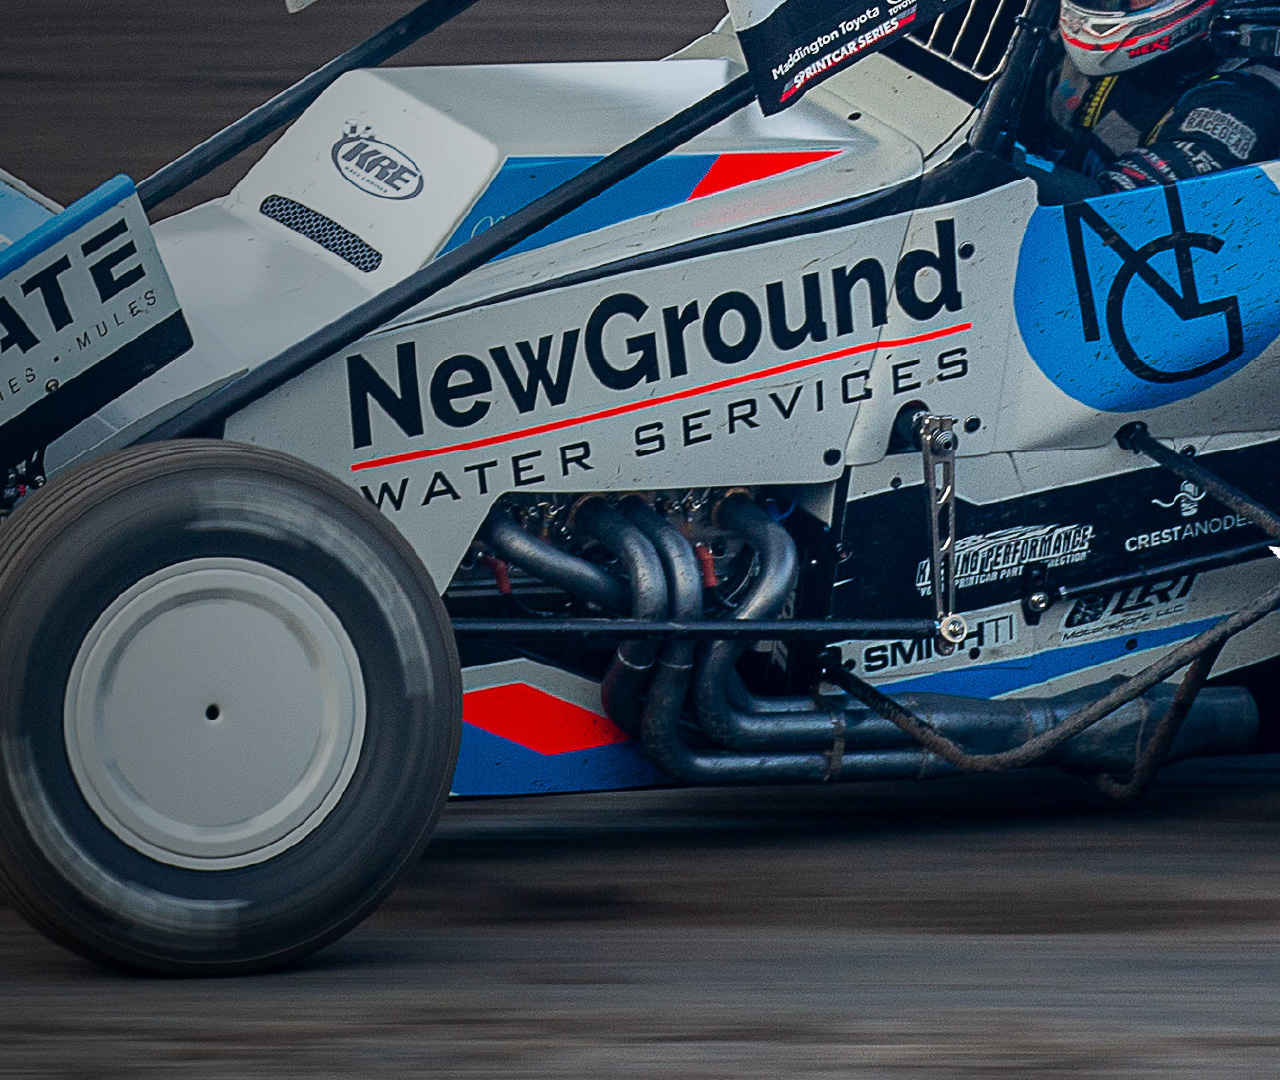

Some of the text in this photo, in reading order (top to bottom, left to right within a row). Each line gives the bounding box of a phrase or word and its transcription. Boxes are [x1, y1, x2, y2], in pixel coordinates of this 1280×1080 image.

[771, 6, 881, 81] Maddington Toyota
[793, 17, 899, 89] SPRINTCAR SERIES
[341, 141, 418, 192] KRE
[75, 288, 158, 353] MULES
[345, 218, 964, 449] NewGround
[360, 346, 972, 514] WATER SERVICES
[950, 571, 998, 590] PRINTCAR
[1000, 565, 1024, 580] PART
[863, 614, 1015, 673] SMIHTI
